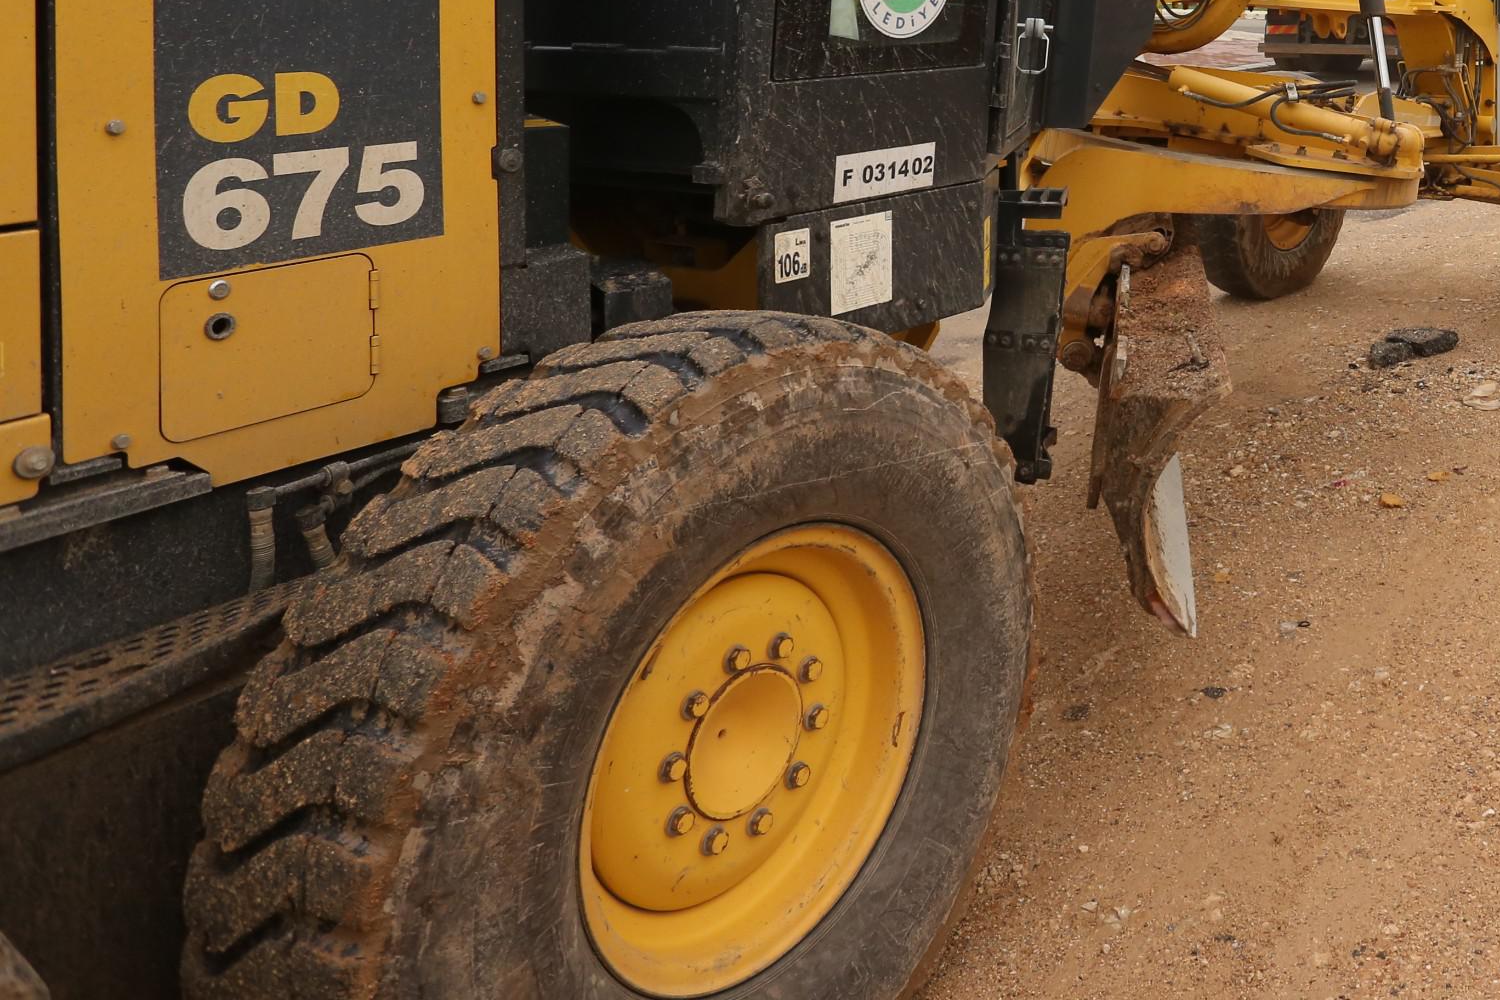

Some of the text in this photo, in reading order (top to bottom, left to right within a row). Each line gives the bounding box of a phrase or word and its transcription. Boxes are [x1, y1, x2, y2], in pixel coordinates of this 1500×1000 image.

[188, 71, 341, 143] GD
[182, 140, 425, 251] 675
[842, 155, 933, 187] F 031402
[778, 251, 801, 279] 106
